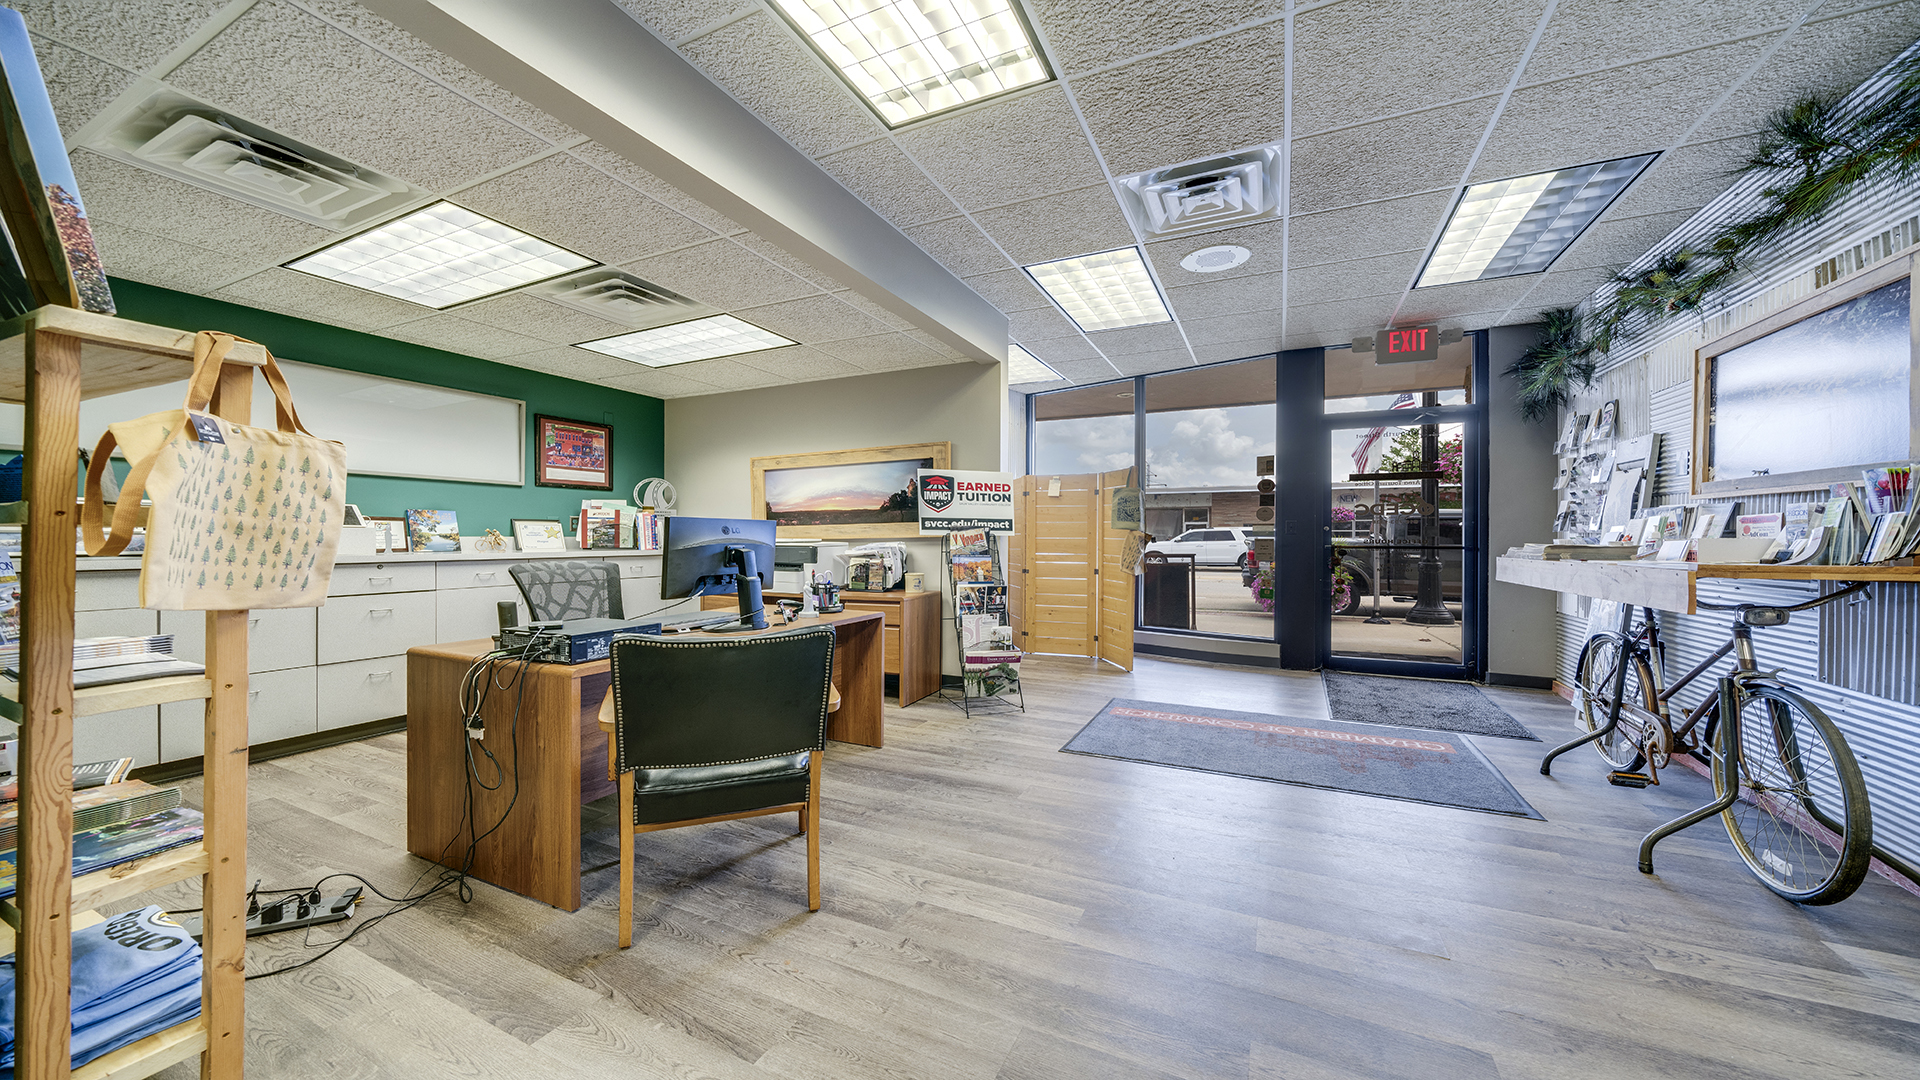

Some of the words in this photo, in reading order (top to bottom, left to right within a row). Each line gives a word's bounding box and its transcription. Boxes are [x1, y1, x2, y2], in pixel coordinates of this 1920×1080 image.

[1389, 329, 1428, 353] EXIT
[957, 482, 1011, 492] EARNED
[923, 491, 952, 501] IMPACT
[957, 492, 1011, 503] TUITION
[924, 519, 1010, 528] svcc.edu/impact
[1115, 708, 1254, 729] COMMERCE
[1259, 725, 1296, 734] OF
[1303, 729, 1446, 751] CHAMBER
[104, 907, 183, 952] OREGO
